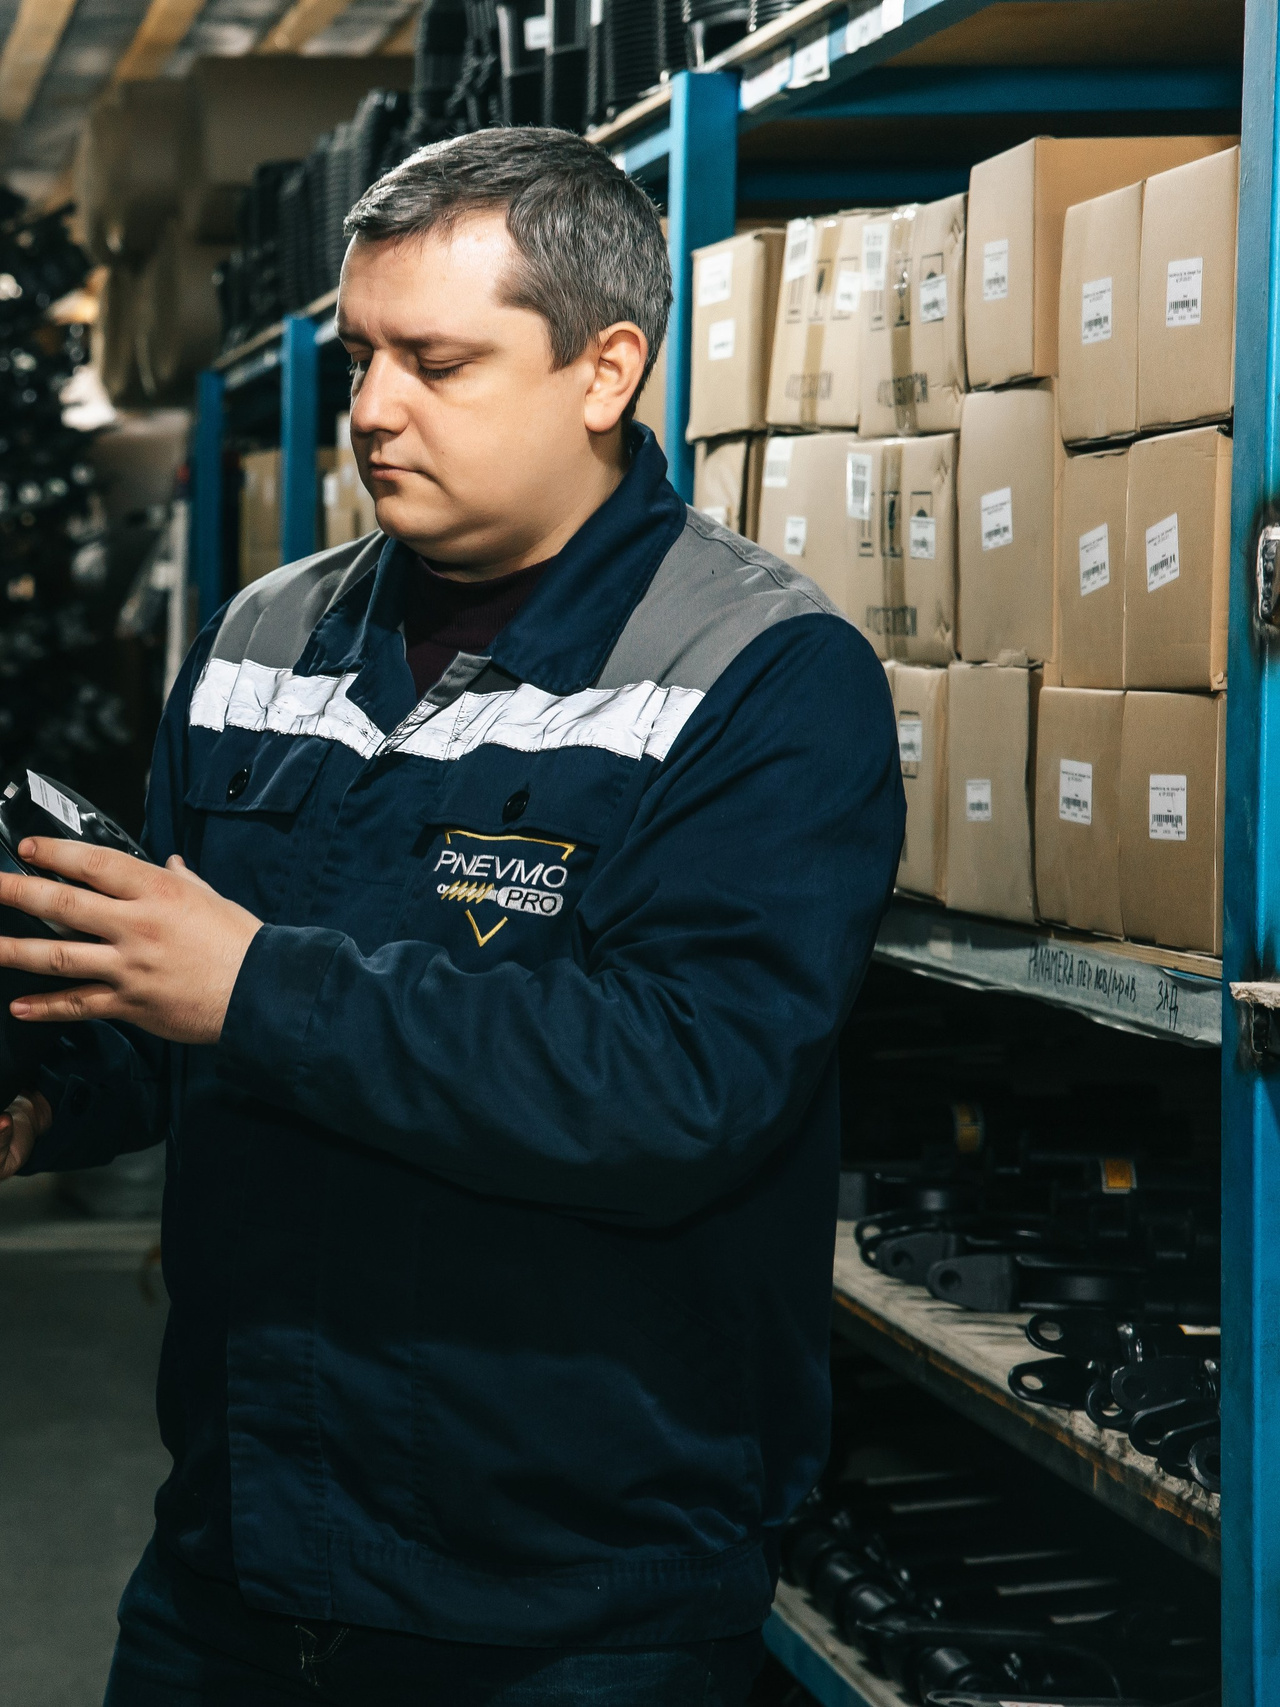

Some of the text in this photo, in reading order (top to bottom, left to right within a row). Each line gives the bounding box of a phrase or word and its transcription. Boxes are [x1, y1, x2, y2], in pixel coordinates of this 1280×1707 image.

[433, 849, 568, 889] PNEVMO
[504, 889, 558, 914] PRO
[1028, 943, 1074, 986] PANAMERA
